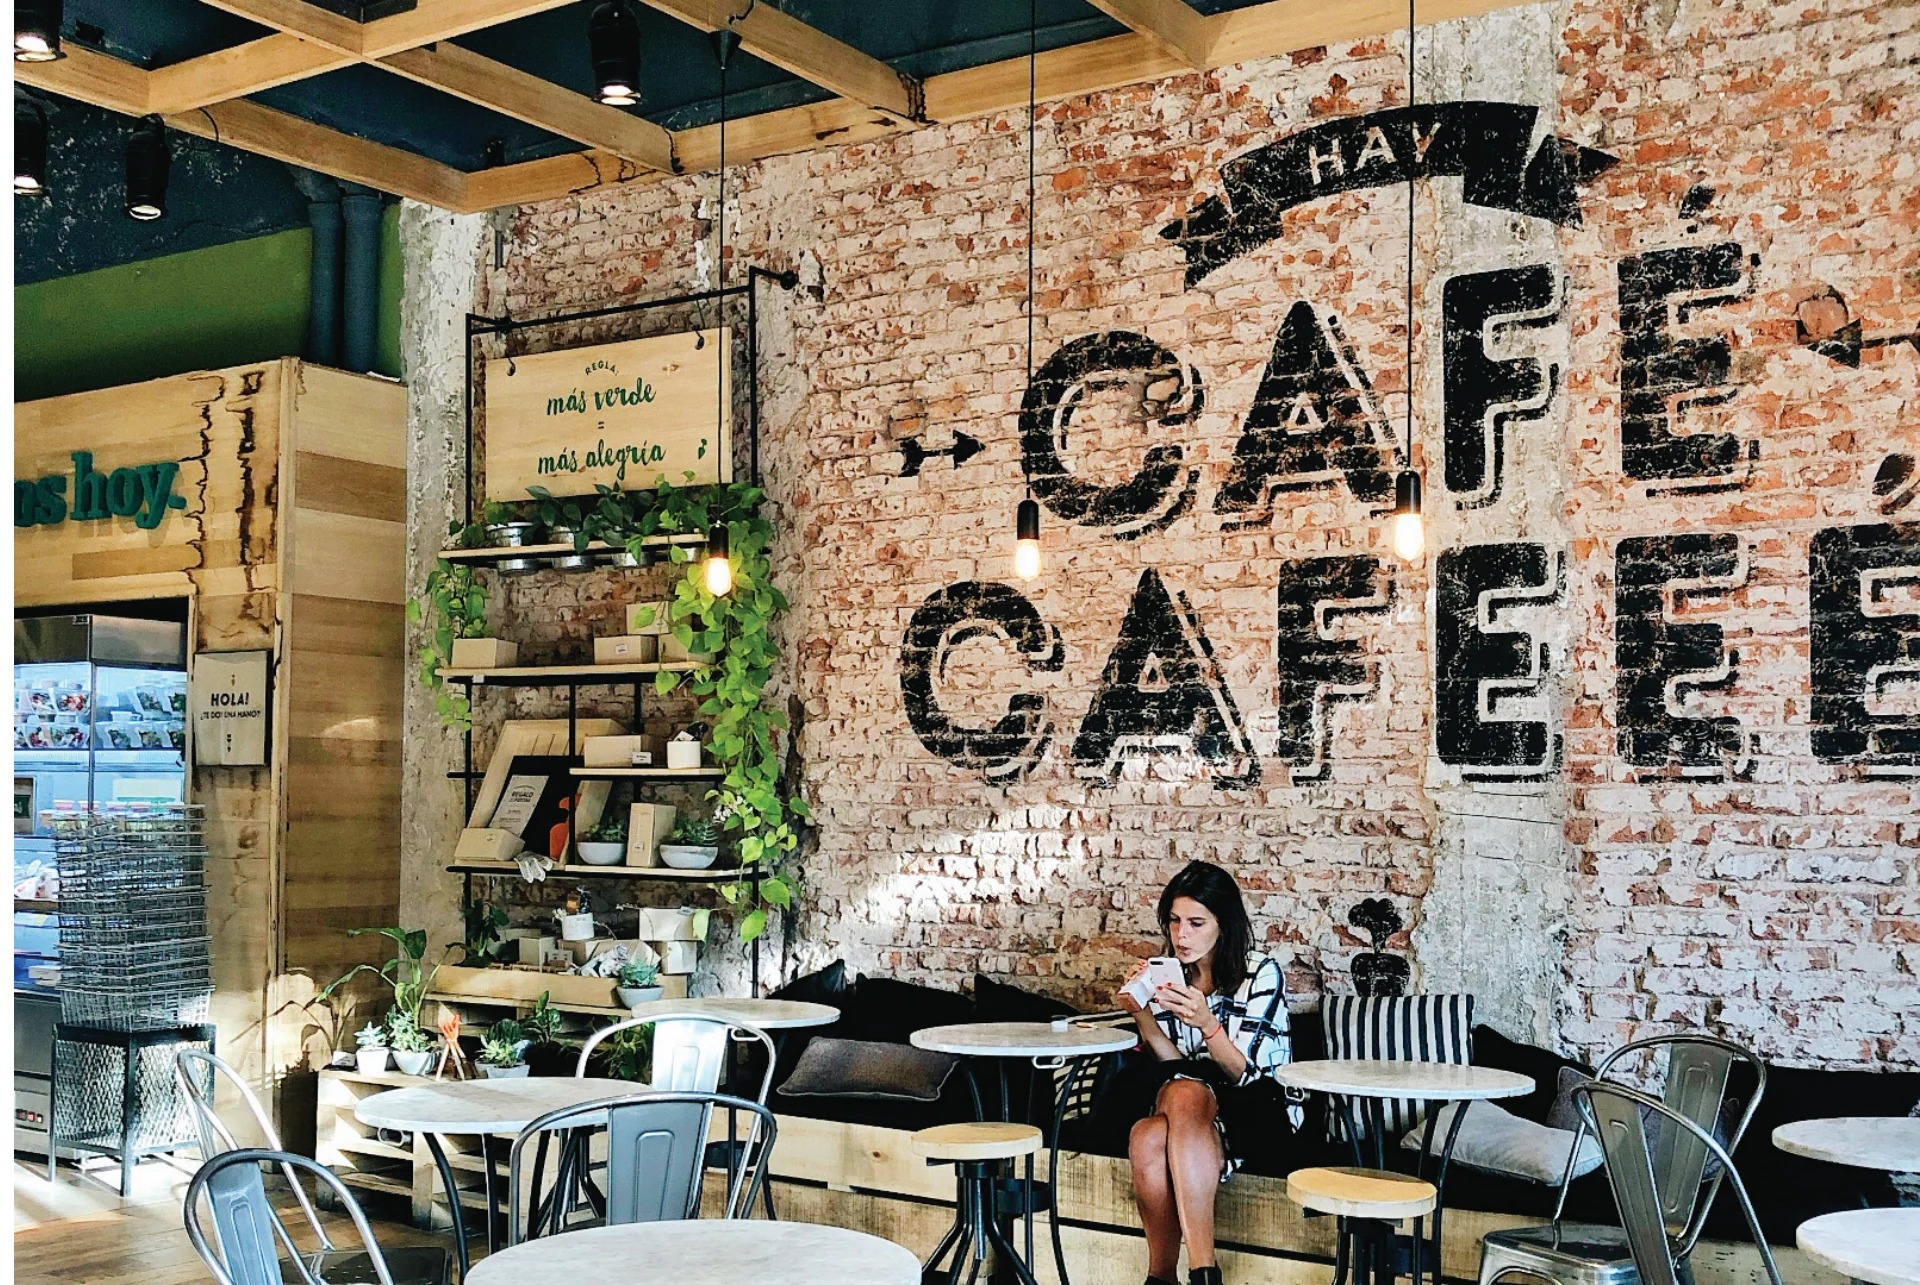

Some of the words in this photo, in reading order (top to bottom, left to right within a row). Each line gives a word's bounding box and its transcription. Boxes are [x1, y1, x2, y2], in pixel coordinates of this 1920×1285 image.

[1308, 121, 1442, 186] HAY
[1017, 183, 1761, 541] CAFÉ
[546, 387, 587, 416] más
[594, 377, 657, 411] verde
[537, 446, 579, 475] más
[586, 439, 667, 481] alegría
[211, 692, 249, 706] HOLA!
